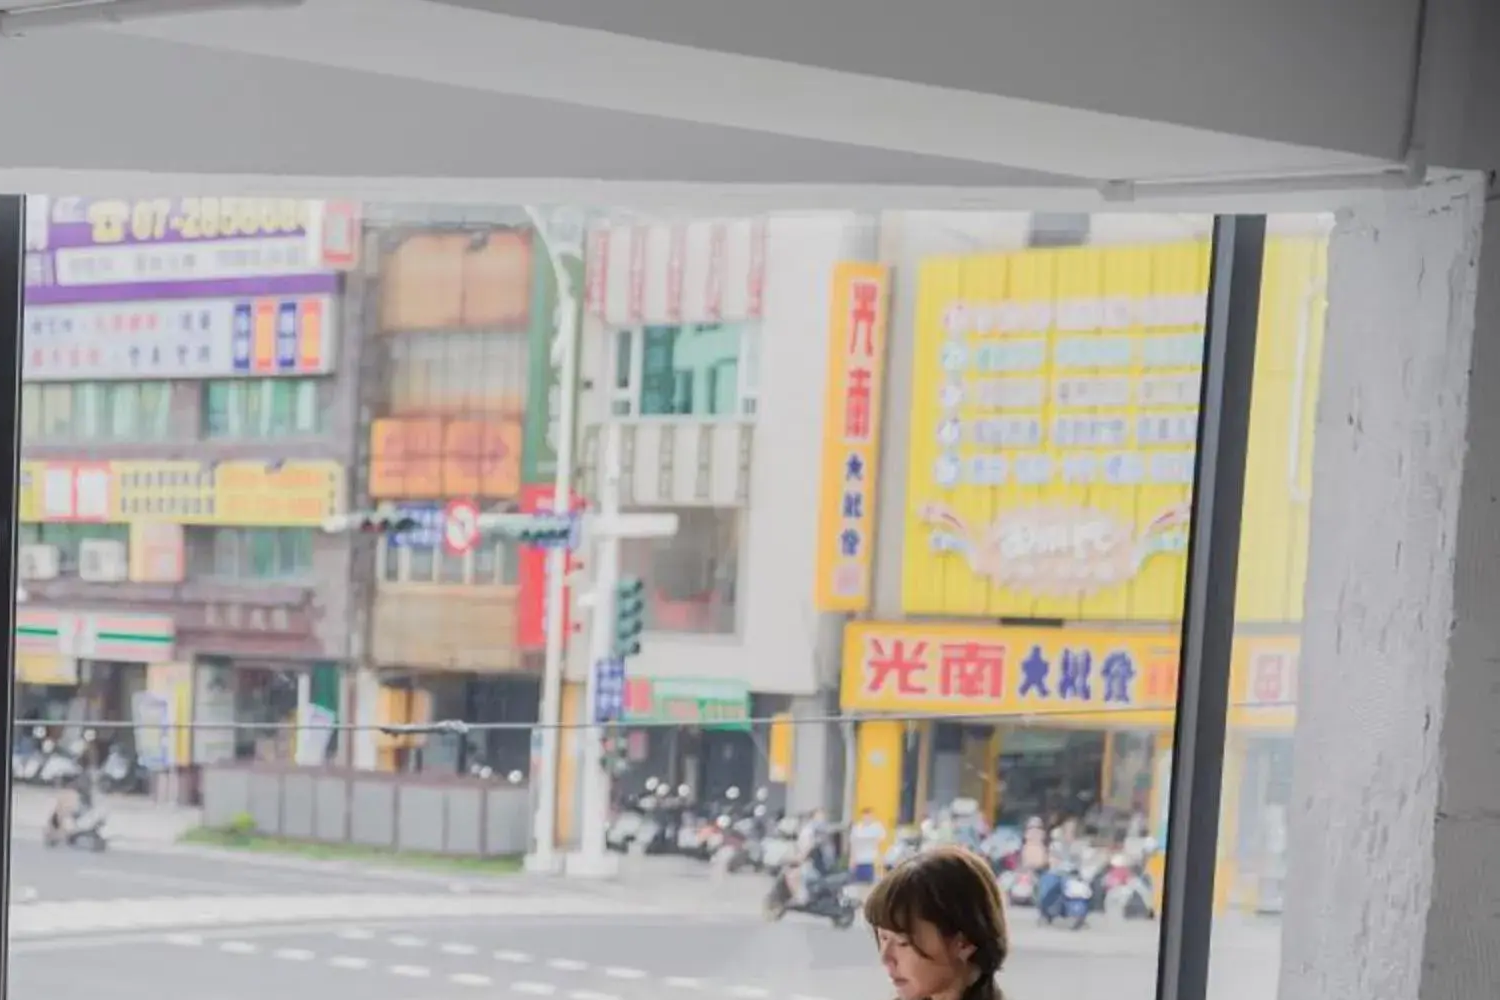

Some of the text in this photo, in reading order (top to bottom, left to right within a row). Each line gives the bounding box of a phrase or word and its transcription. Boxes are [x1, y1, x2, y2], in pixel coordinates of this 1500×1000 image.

[865, 637, 1137, 704] 光南大批發
